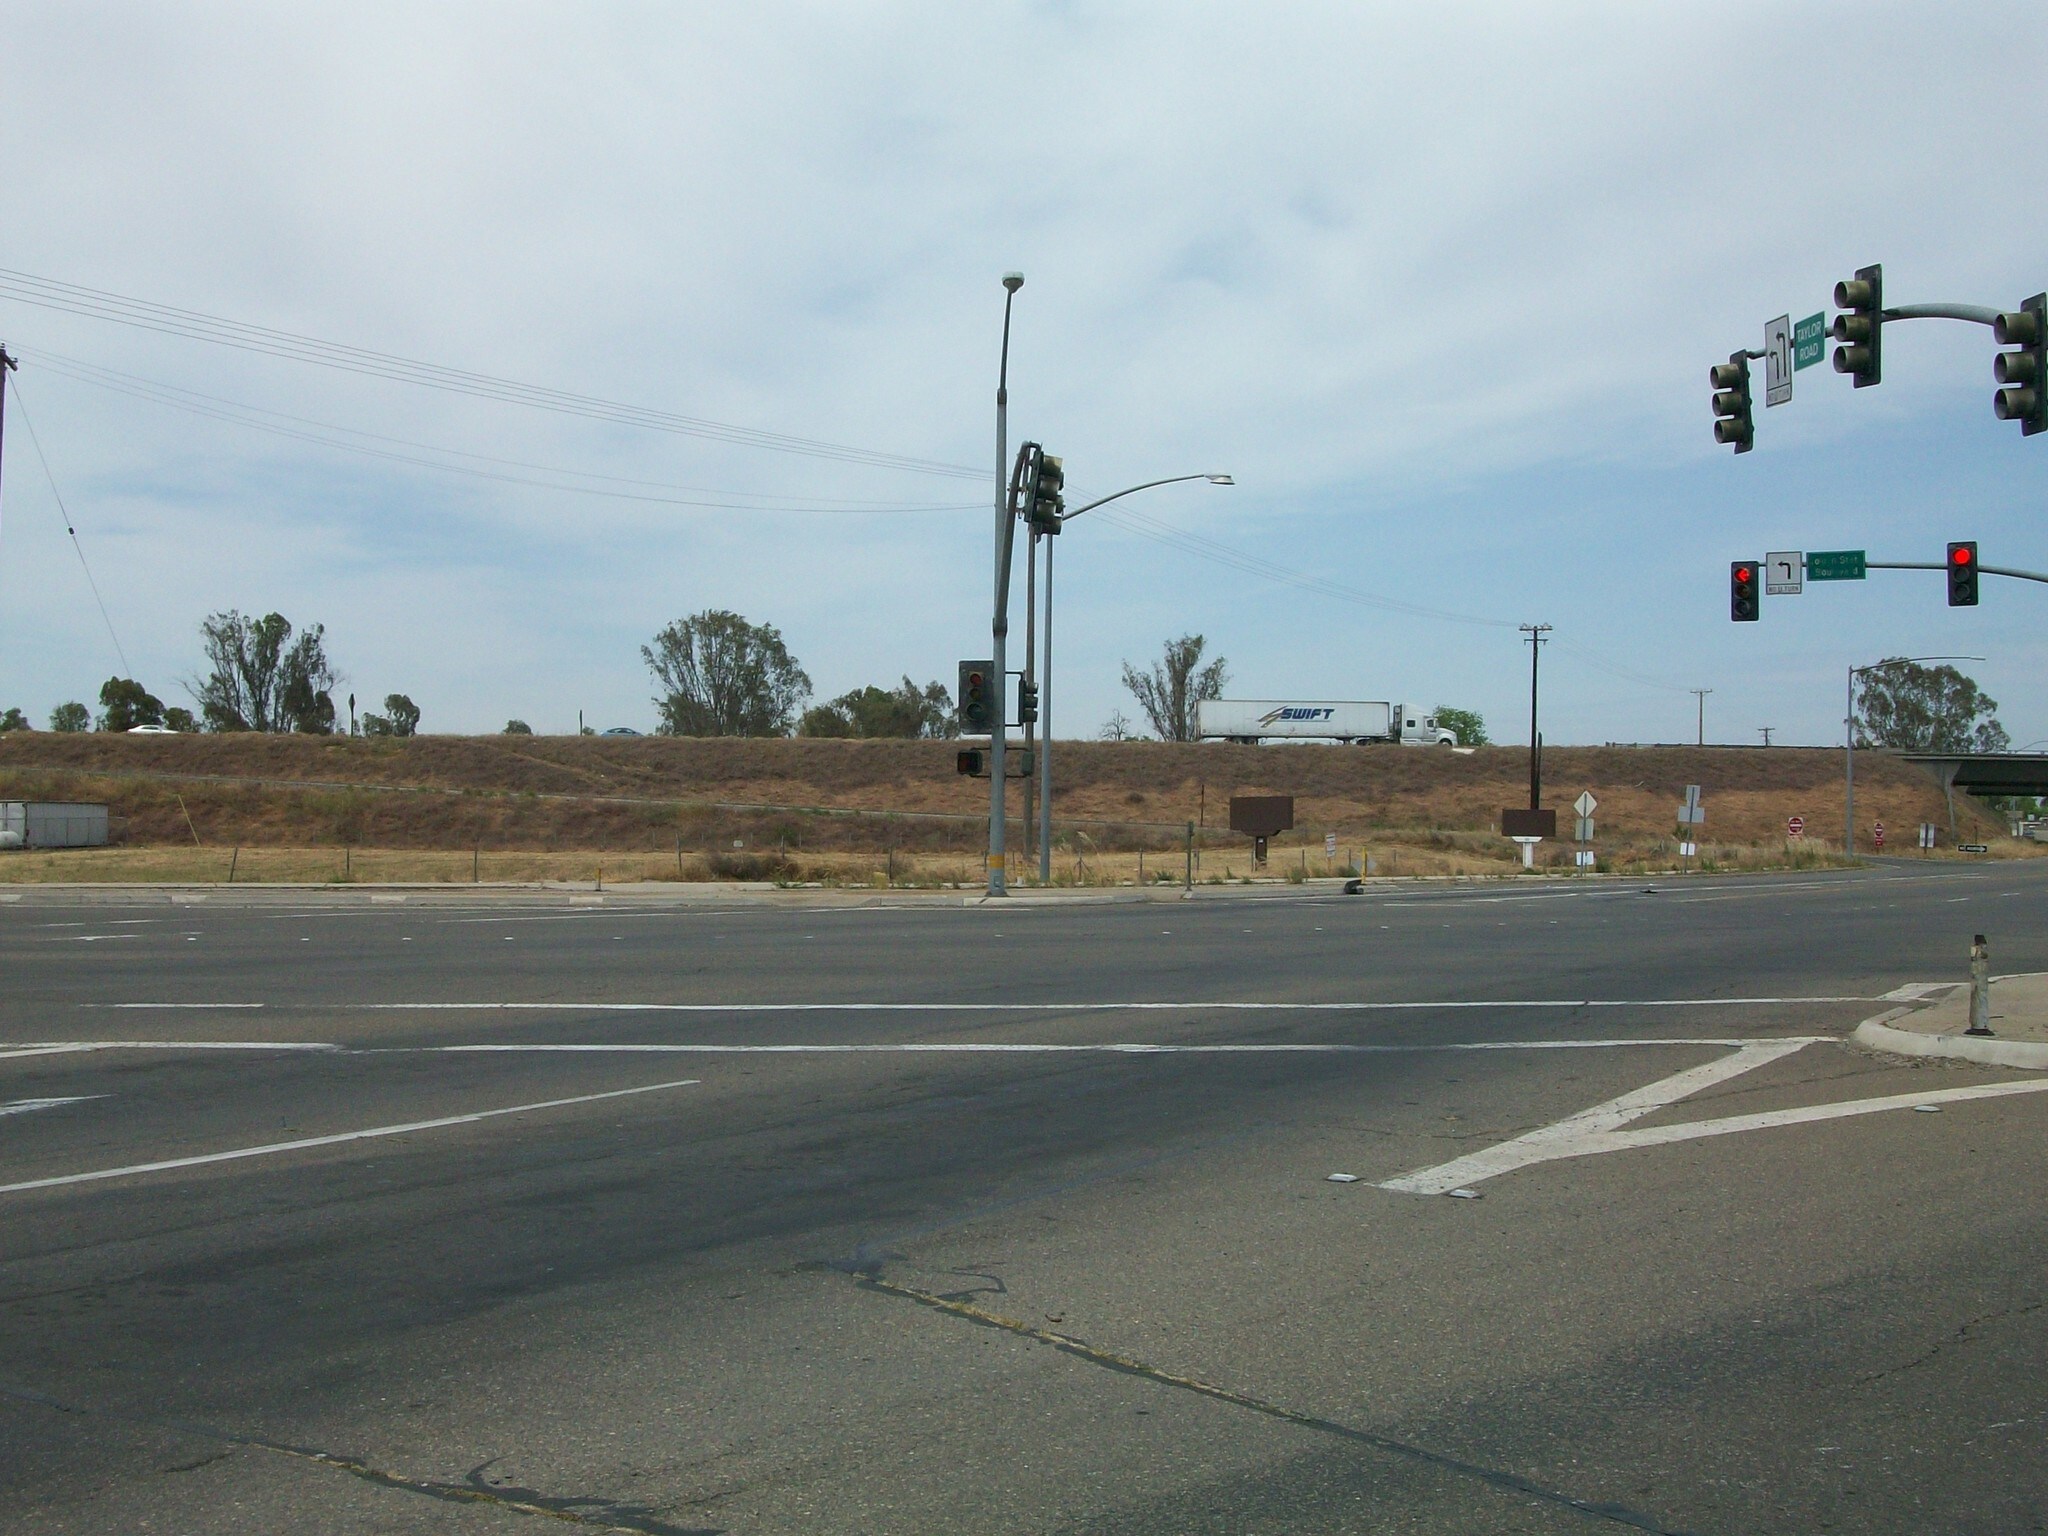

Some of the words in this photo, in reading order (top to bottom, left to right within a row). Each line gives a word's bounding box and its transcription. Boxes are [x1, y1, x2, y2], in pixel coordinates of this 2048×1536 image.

[1797, 321, 1821, 341] TAYLOR
[1799, 343, 1818, 361] ROAD
[1280, 708, 1335, 720] SWIFT
